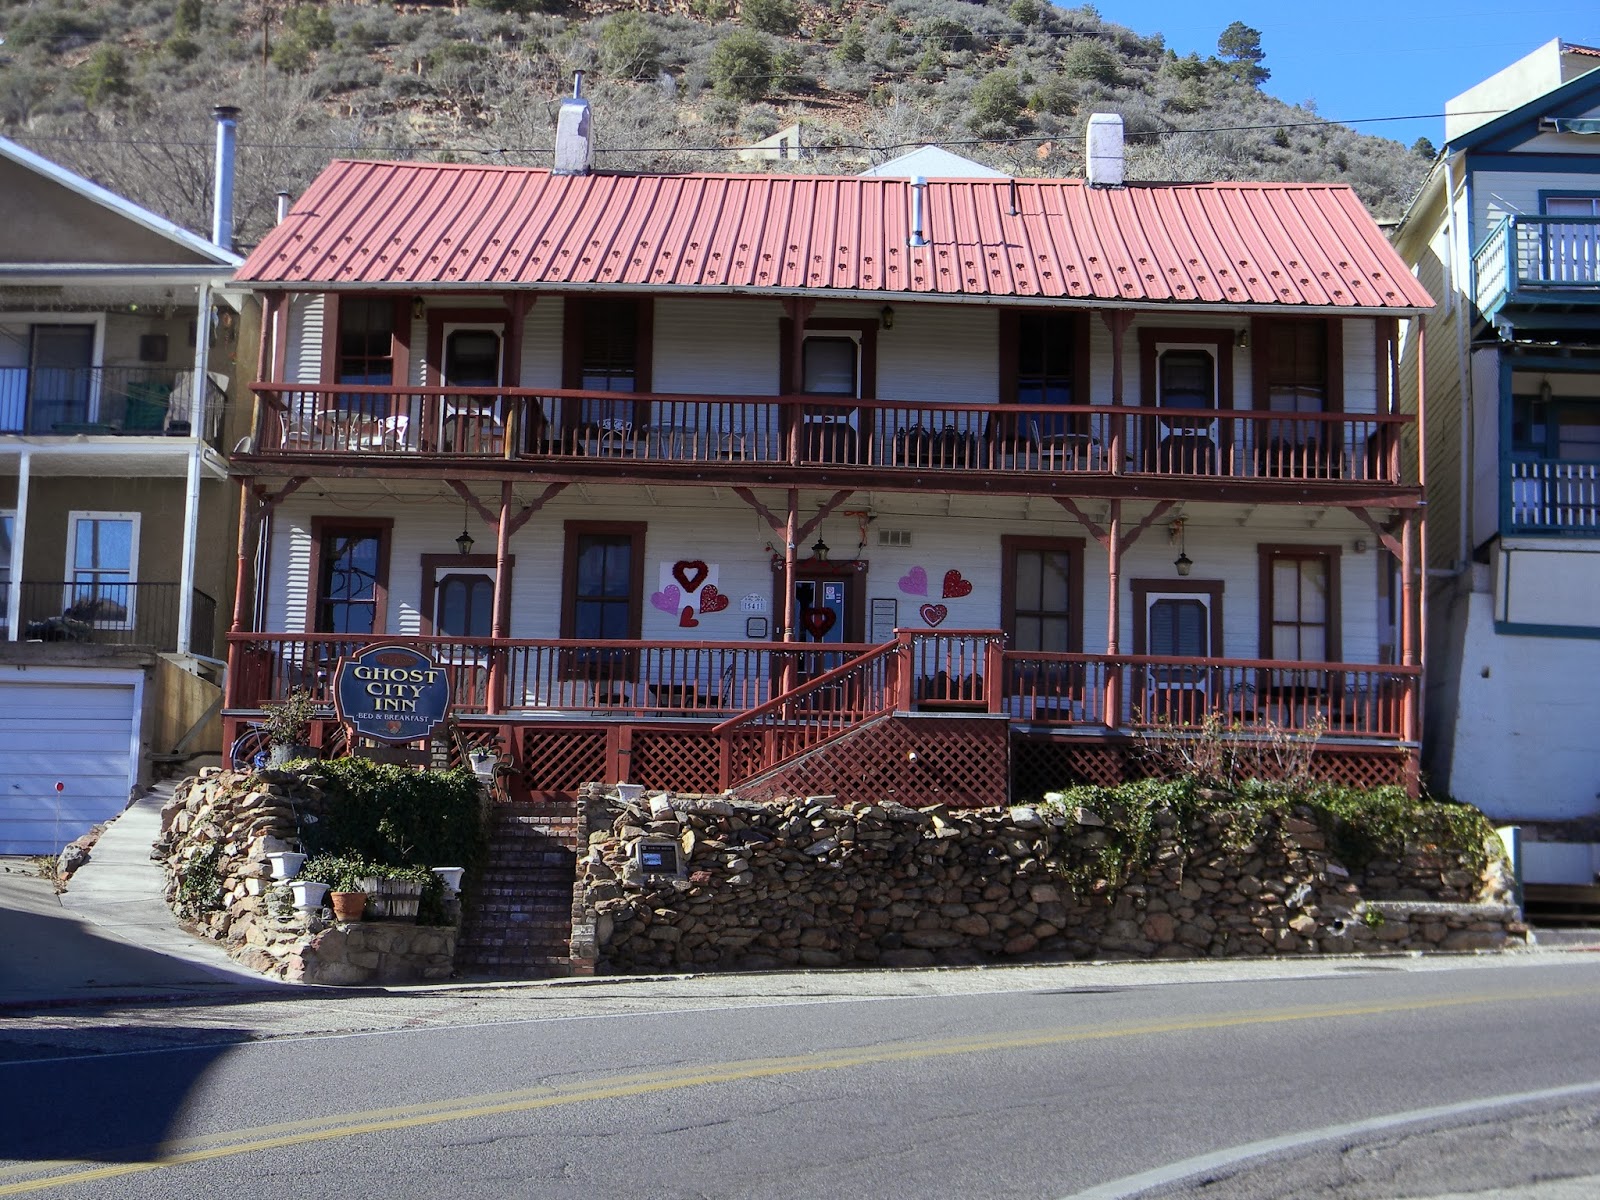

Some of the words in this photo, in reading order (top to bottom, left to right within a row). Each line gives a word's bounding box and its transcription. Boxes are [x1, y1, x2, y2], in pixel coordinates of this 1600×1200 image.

[354, 666, 438, 684] GHOST
[366, 682, 425, 698] CITY
[374, 698, 418, 713] INN
[358, 712, 374, 720] BED
[384, 713, 430, 722] BREAKFAST
